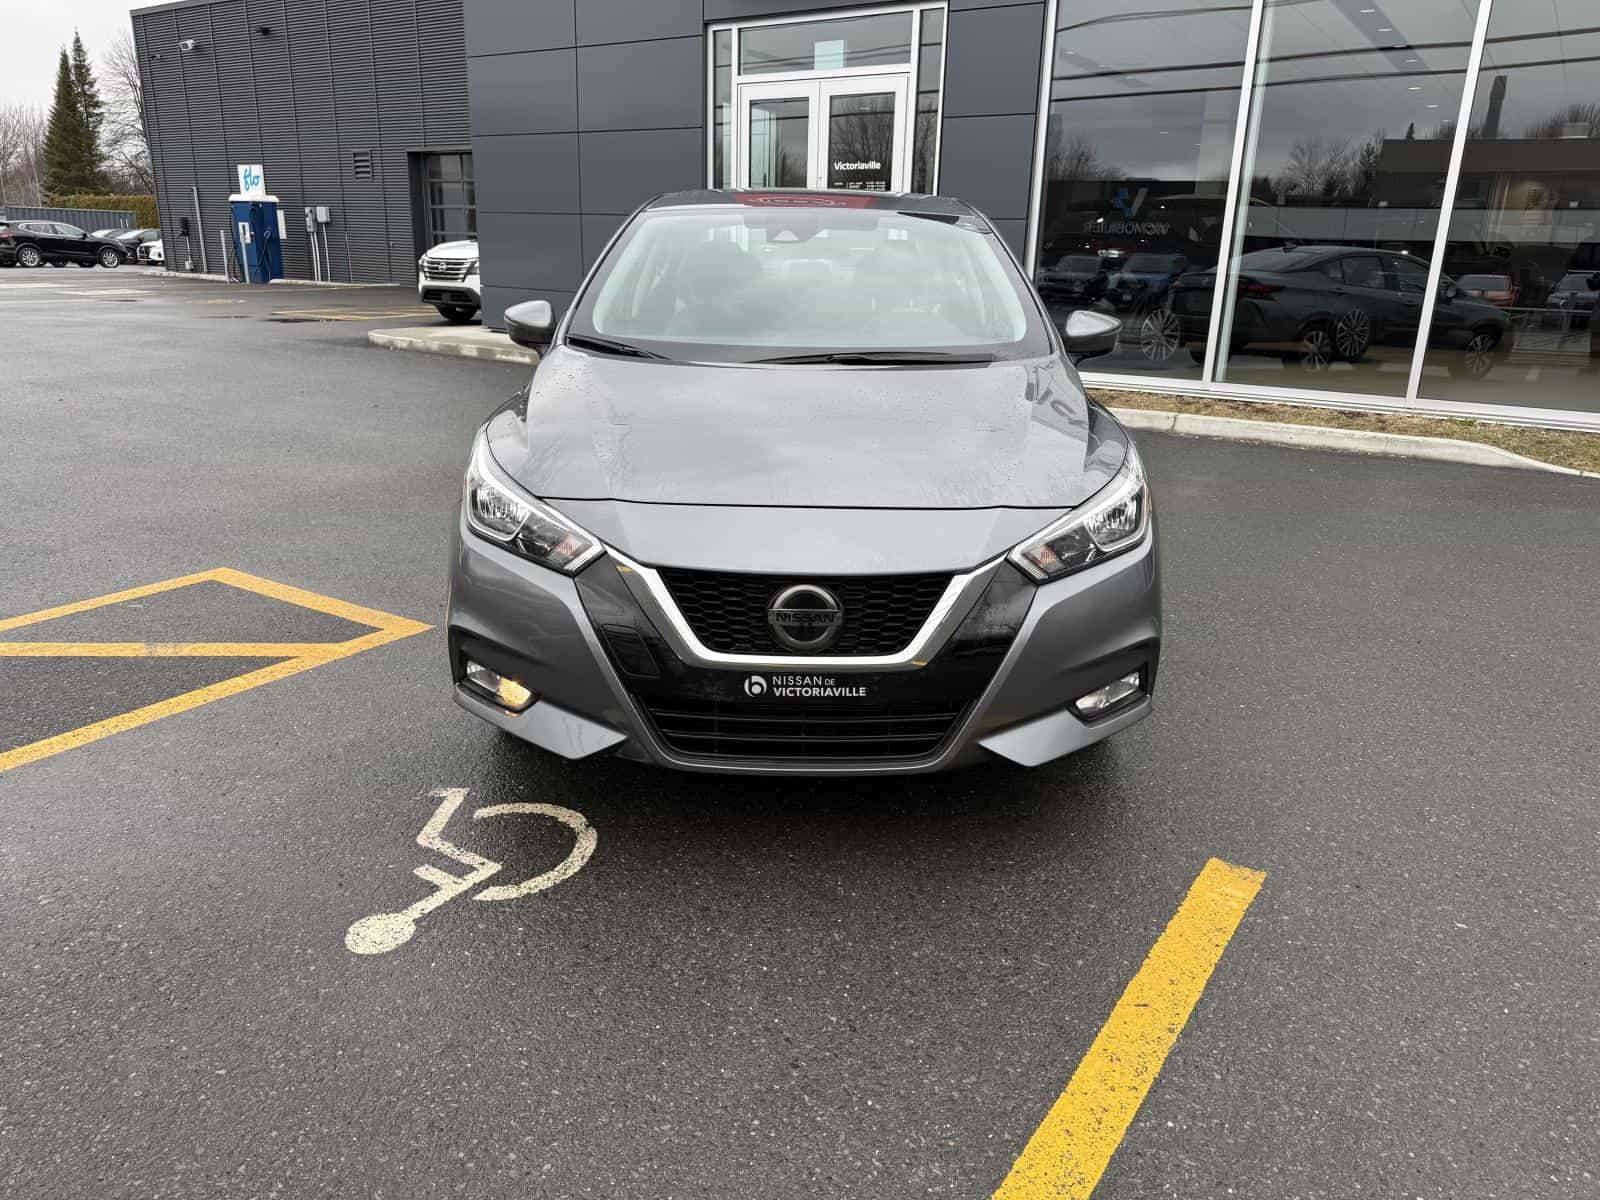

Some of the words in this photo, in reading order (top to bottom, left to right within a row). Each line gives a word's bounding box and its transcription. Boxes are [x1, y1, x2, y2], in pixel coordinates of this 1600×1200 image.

[834, 160, 881, 171] Victoriaville
[243, 166, 261, 191] flo
[775, 611, 835, 624] NISSAN
[772, 675, 822, 686] NISSAN
[824, 678, 836, 686] DE
[773, 687, 867, 697] VICTORIAVILLE
